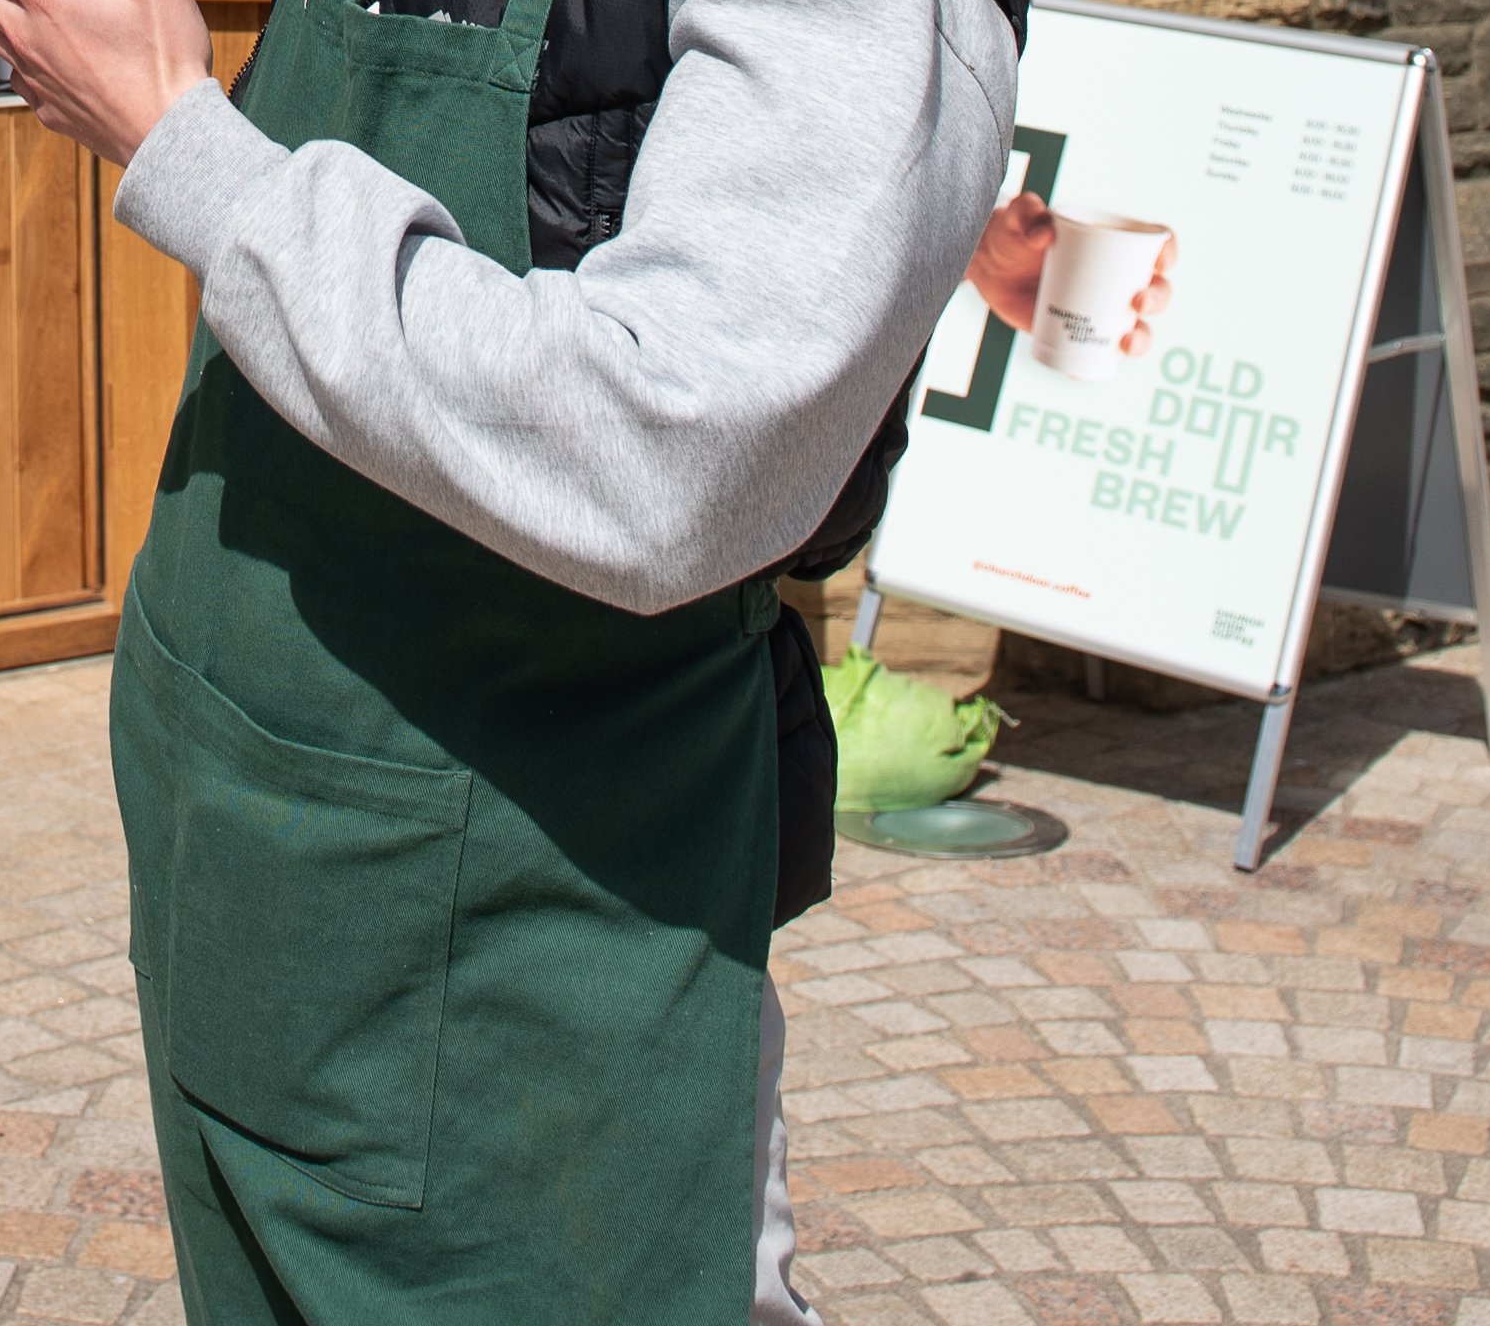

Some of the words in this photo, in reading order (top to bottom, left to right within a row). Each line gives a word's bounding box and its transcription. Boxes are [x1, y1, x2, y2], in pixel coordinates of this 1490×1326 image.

[1161, 346, 1264, 400] OLD
[1005, 401, 1176, 477] FRESH
[1090, 469, 1247, 541] BREW
